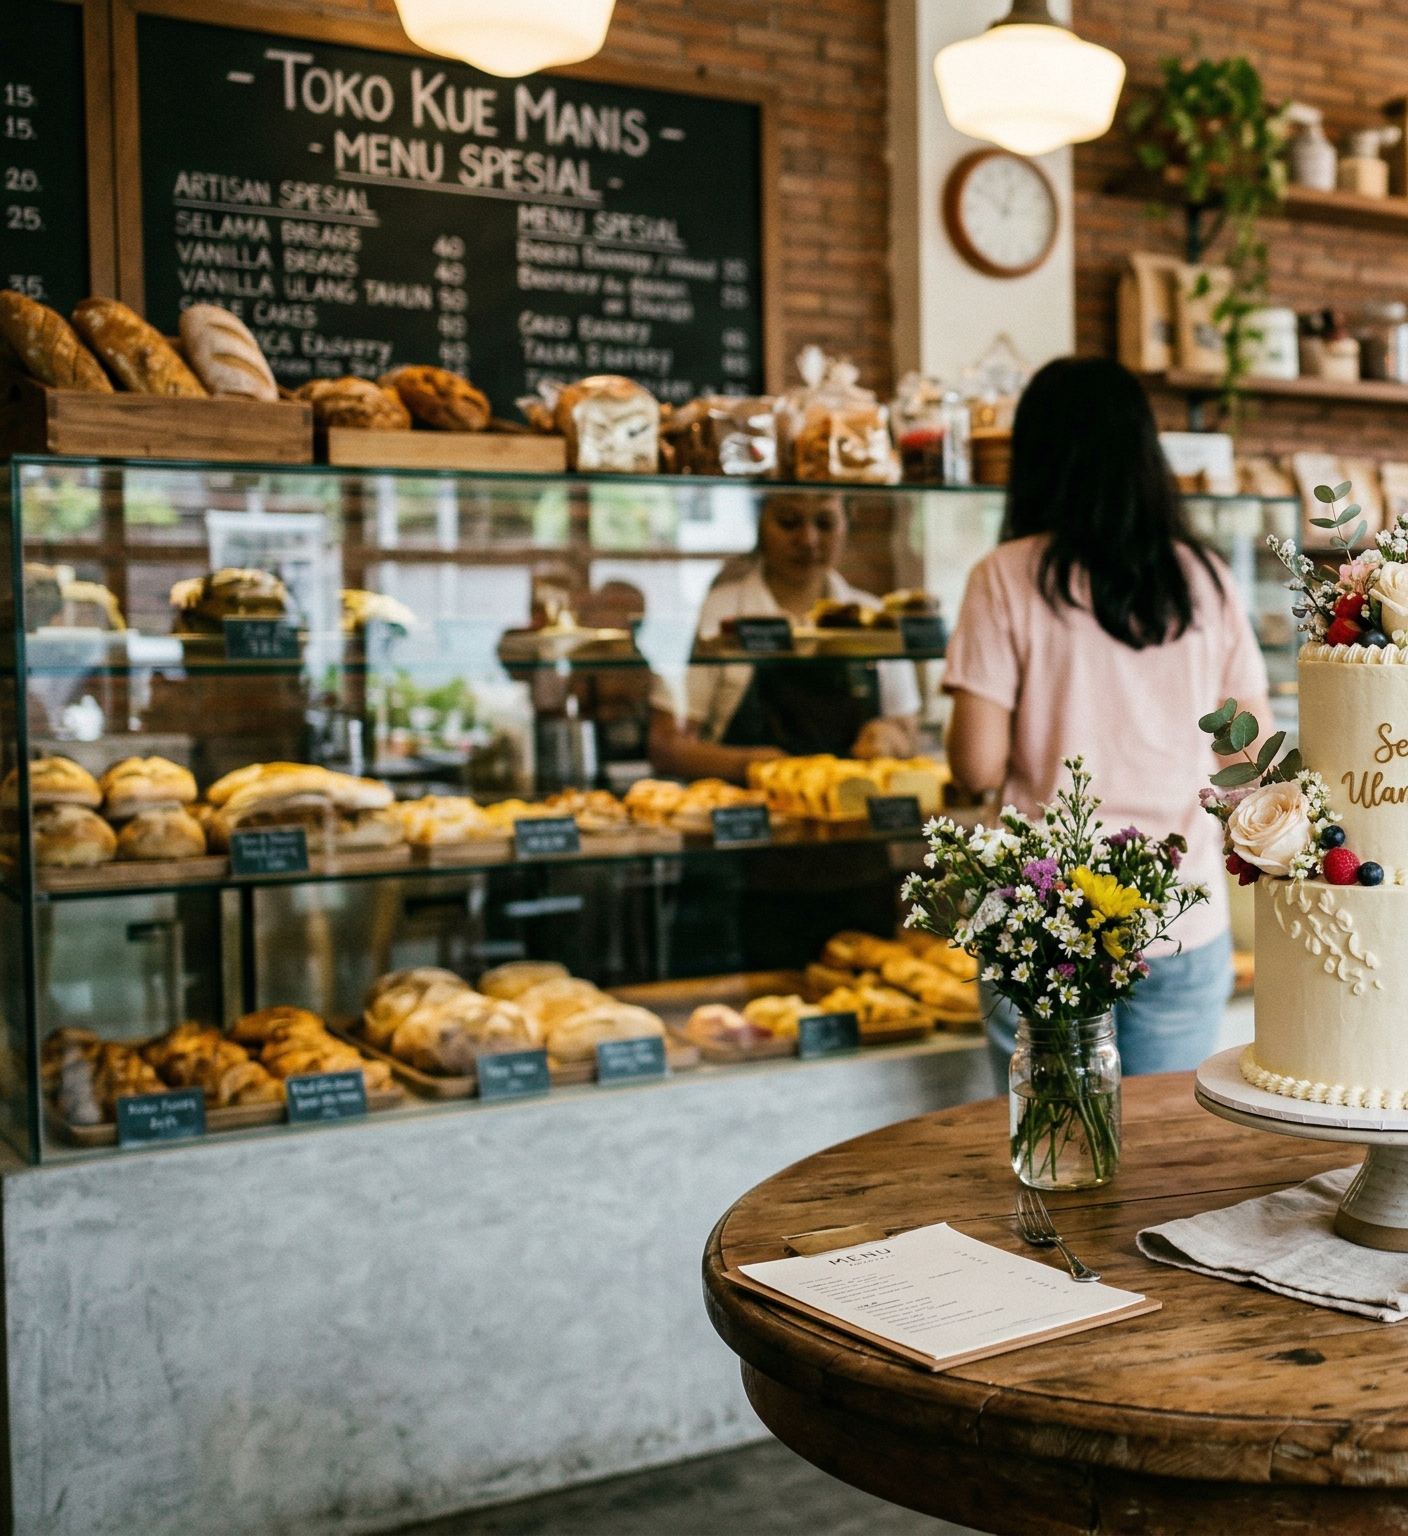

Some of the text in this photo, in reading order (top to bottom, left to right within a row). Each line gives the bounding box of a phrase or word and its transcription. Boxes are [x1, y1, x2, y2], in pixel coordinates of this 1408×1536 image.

[264, 48, 651, 158] TOKO KUE MANIS
[334, 129, 600, 197] MENU SPESIAL
[173, 170, 377, 218] ARTISAN SPESIAL
[175, 211, 271, 243] SELAMA
[517, 204, 585, 237] MENU
[175, 240, 274, 270] VANILLA
[177, 268, 275, 298] VANILLA
[282, 276, 358, 304] ULANG
[828, 1248, 891, 1266] MENU
